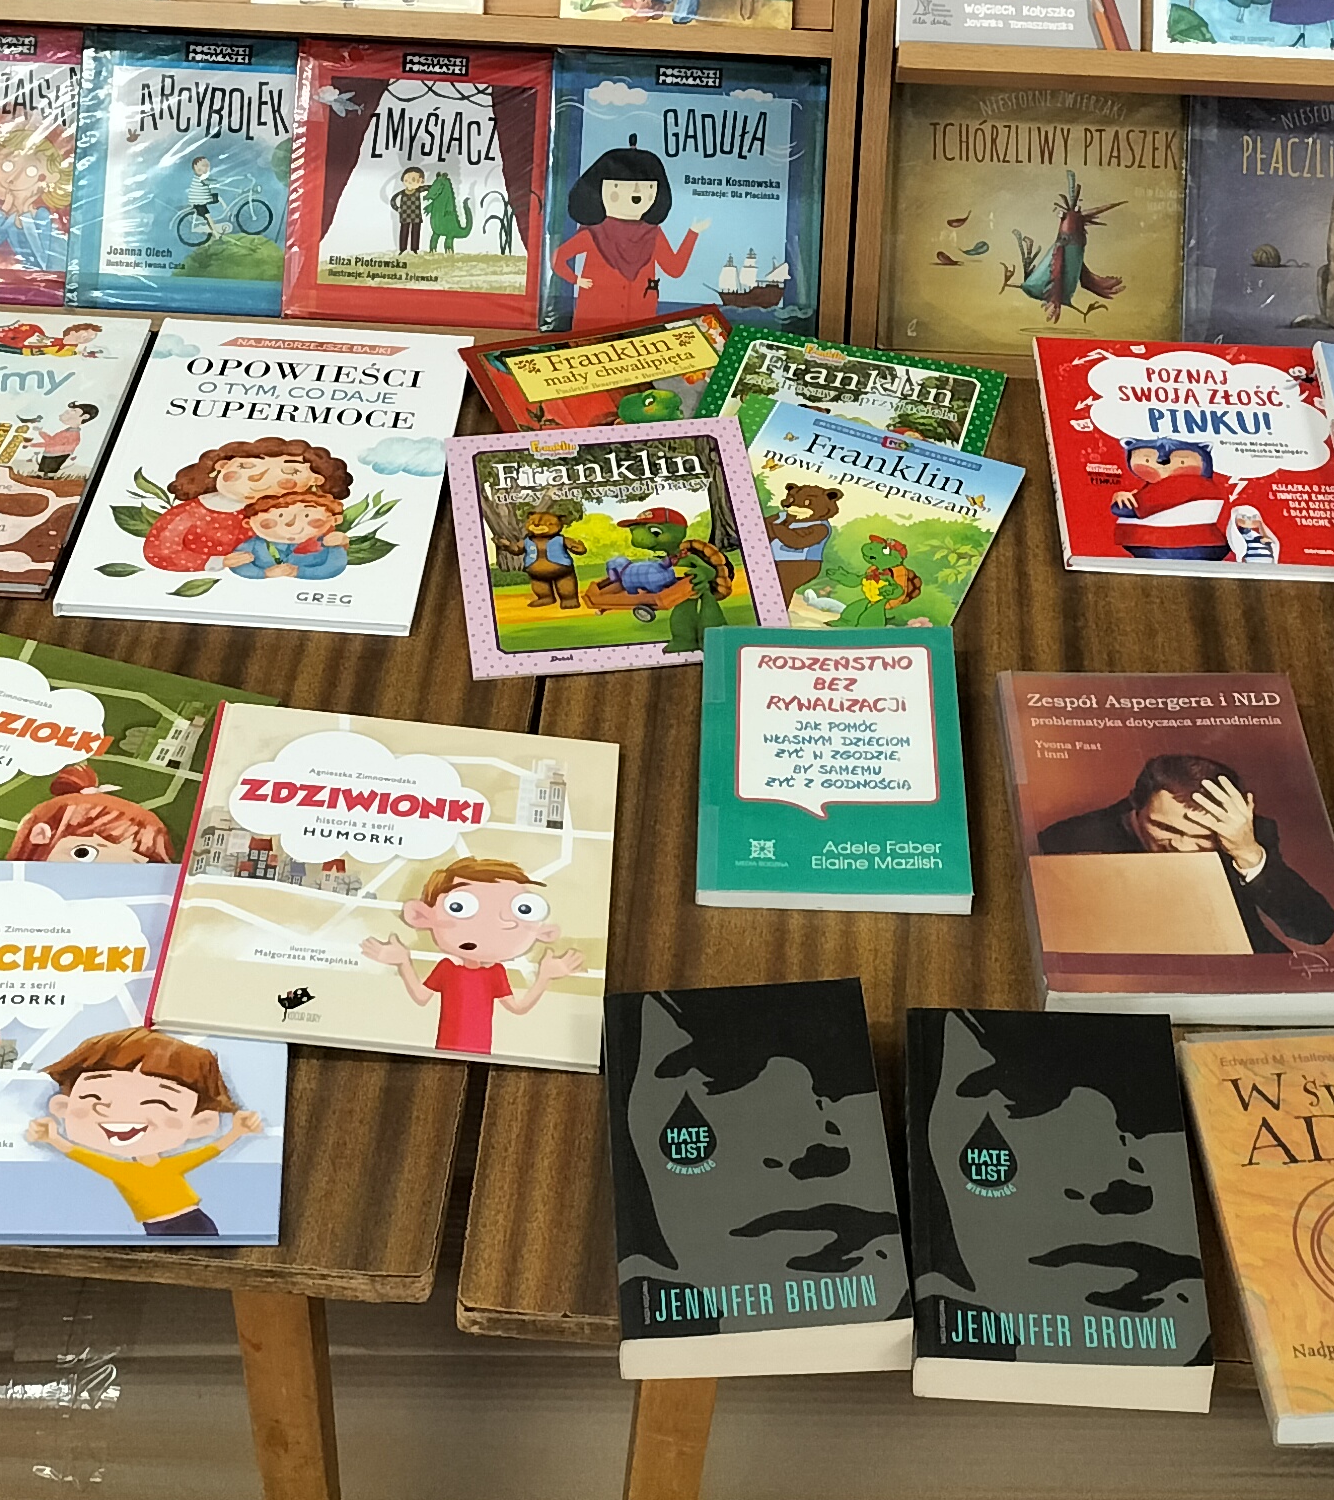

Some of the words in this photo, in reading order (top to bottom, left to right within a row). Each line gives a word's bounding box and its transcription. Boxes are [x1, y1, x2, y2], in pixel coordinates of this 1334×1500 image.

[139, 74, 290, 141] ARCYBOLEK
[369, 107, 497, 166] ZMYŚLACZ
[663, 109, 768, 160] GADUŁA
[929, 121, 1072, 167] TCHÓRZLIWY
[684, 174, 722, 187] Barbara
[725, 177, 781, 189] Kosmowska
[353, 344, 392, 356] BAJKI
[542, 336, 672, 372] Franklin
[186, 356, 426, 390] OPOWIEŚCI
[543, 367, 591, 391] mały
[1146, 367, 1228, 386] POZNAJ
[222, 382, 281, 401] TYM,
[331, 389, 398, 405] DAJE
[1118, 385, 1202, 406] SWOJĄ
[165, 398, 417, 431] SUPERMOCE
[1148, 408, 1273, 435] PINKU!
[492, 453, 706, 490] Franklin
[763, 449, 825, 474] mówi
[803, 432, 964, 496] Franklin
[296, 591, 353, 606] GREG
[757, 655, 913, 672] RODZEŃSTWO
[813, 677, 858, 692] BEZ
[766, 695, 907, 713] RYWALIZACJI
[1026, 692, 1099, 713] Zespół
[1105, 694, 1213, 712] Aspergera
[1231, 692, 1281, 709] NLD
[794, 720, 822, 732] JAK
[828, 719, 878, 733] POMÓC
[1030, 714, 1122, 731] problematyka
[1125, 717, 1193, 732] dotycząca
[1195, 716, 1281, 728] zatrudnienia
[239, 777, 485, 825] ZDZIWIONKI
[303, 827, 405, 847] HUMORKI
[822, 840, 881, 854] Adele
[886, 841, 942, 854] Faber
[811, 856, 868, 869] Elaine
[874, 856, 942, 870] Mazlish
[4, 925, 72, 935] Zimnowodzka
[30, 980, 56, 990] serii
[667, 1126, 709, 1144] HATE
[671, 1142, 708, 1160] LIST
[967, 1148, 1010, 1166] HATE
[970, 1164, 1009, 1182] LIST
[655, 1283, 774, 1323] JENNIFER
[785, 1274, 877, 1314] BROWN
[951, 1310, 1071, 1347] JENNIFER
[1083, 1315, 1177, 1350] BROWN
